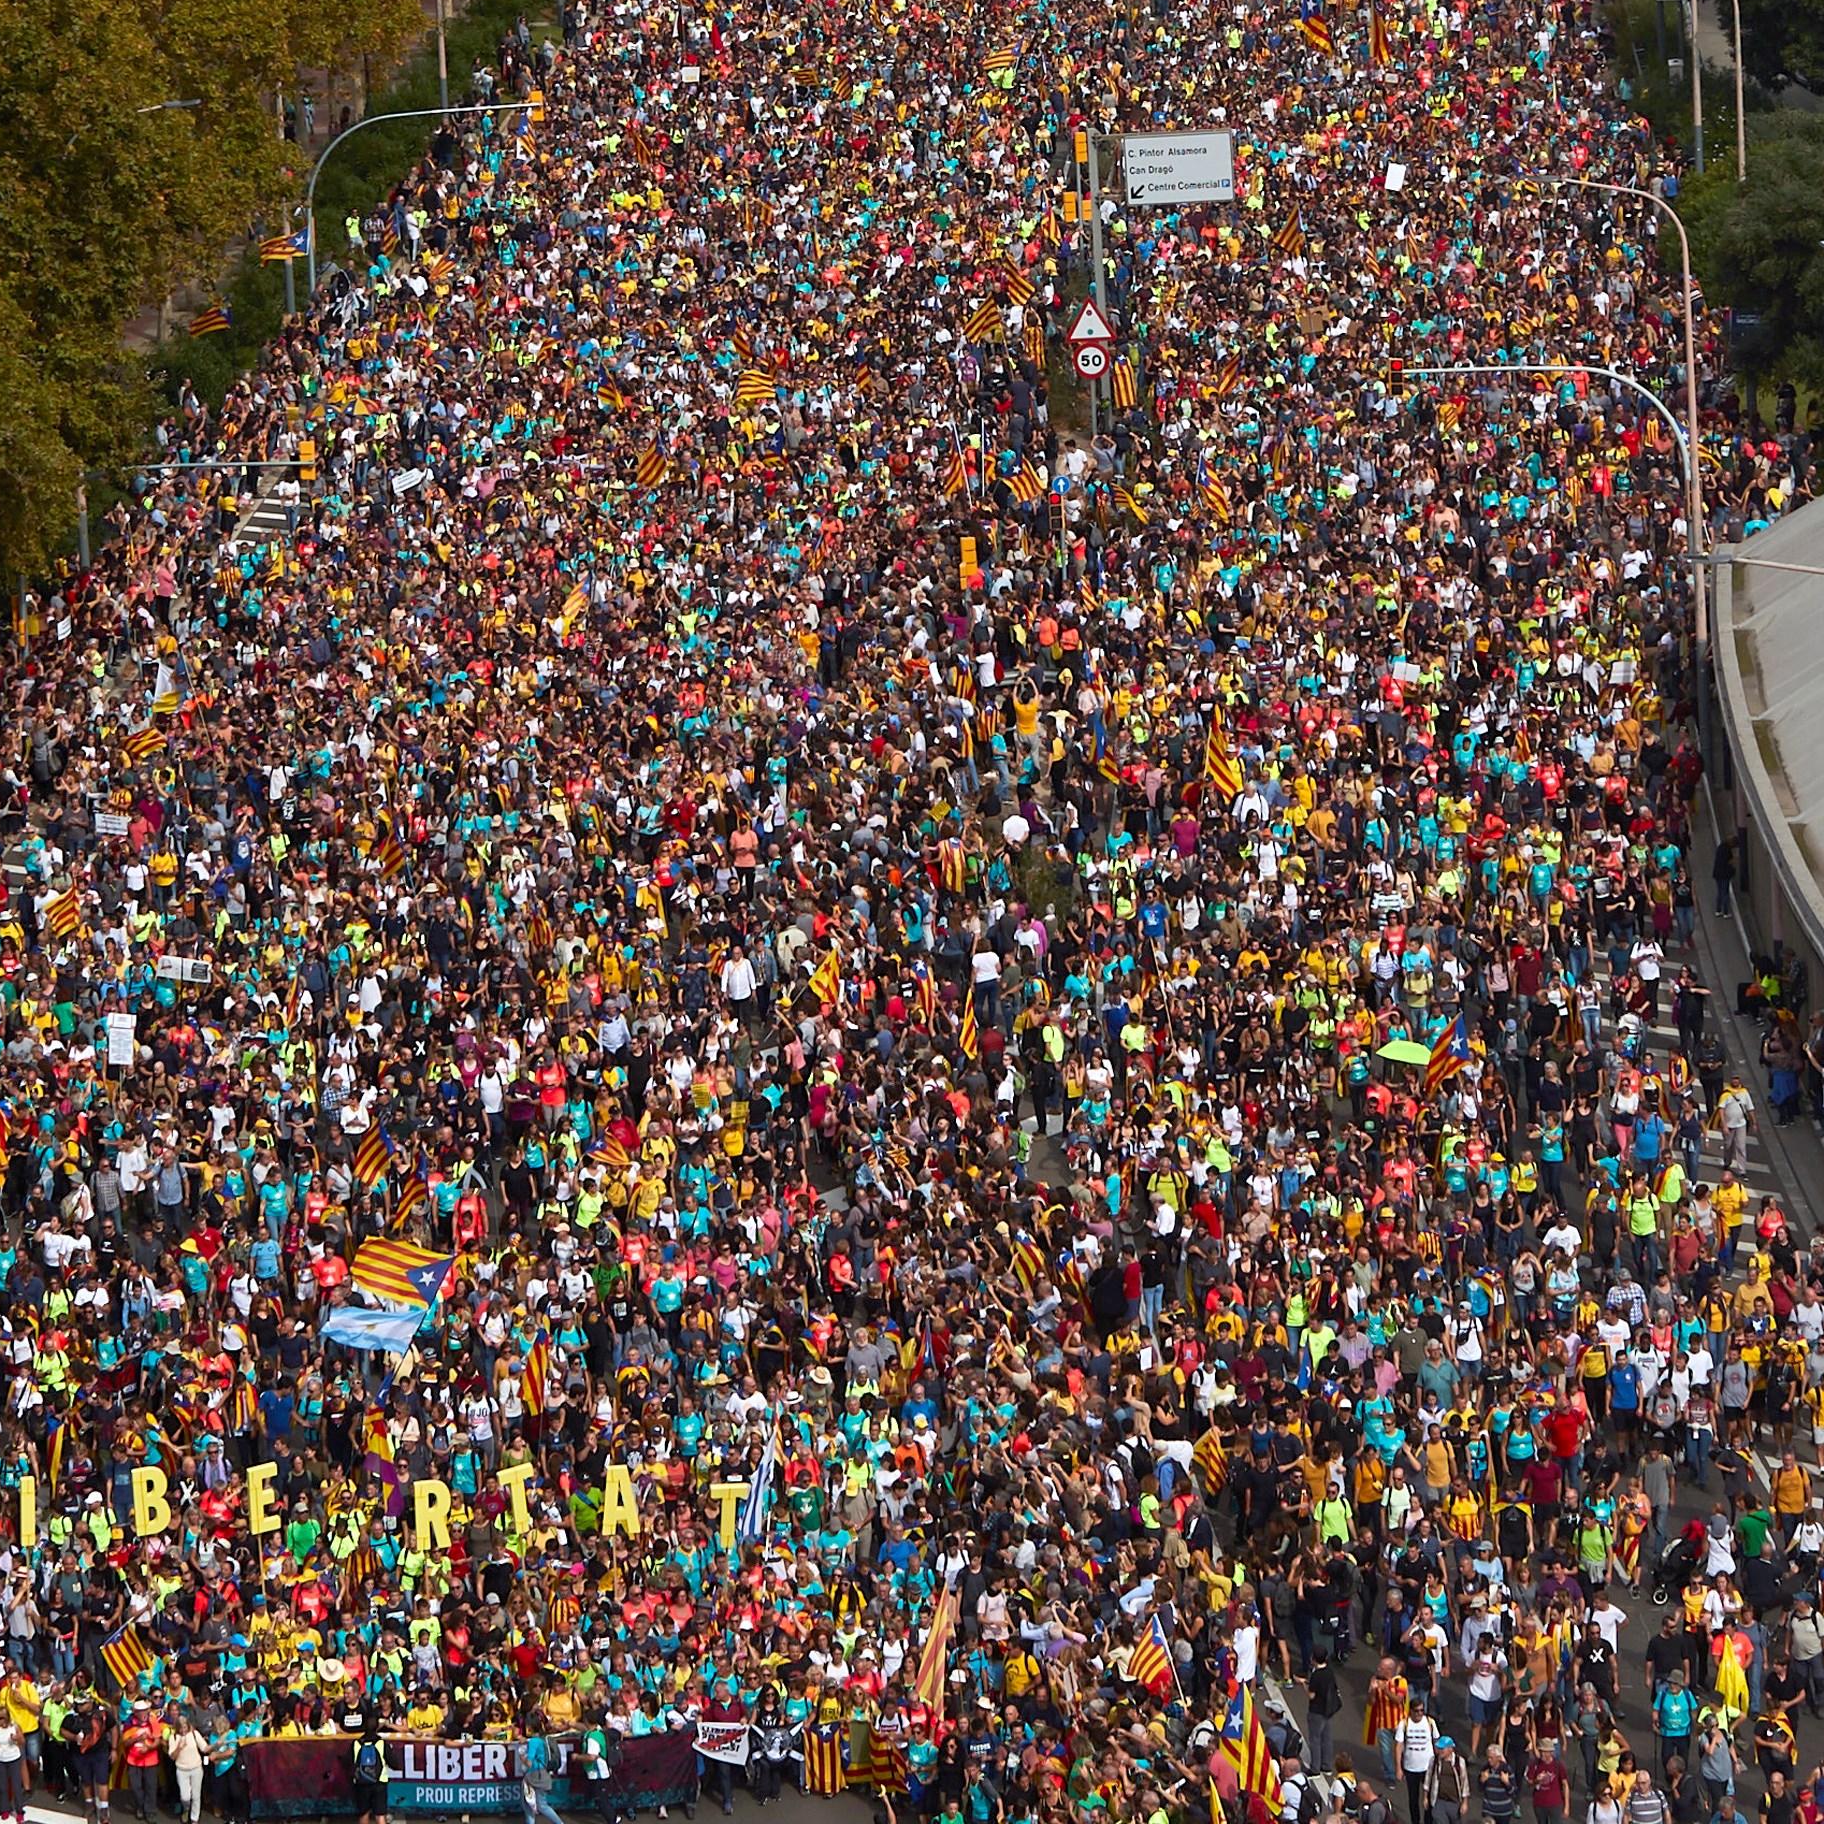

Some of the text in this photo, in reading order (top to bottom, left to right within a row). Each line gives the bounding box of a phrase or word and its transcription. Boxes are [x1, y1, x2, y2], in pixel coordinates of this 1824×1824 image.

[1128, 147, 1207, 158] C. Pintor Alsamora
[1129, 166, 1146, 175] Can
[1148, 182, 1176, 192] Centre
[1178, 180, 1221, 191] Comercial
[1081, 355, 1102, 367] 50
[387, 1743, 574, 1780] LIBERTT
[416, 1785, 521, 1804] PROU REPRESS
